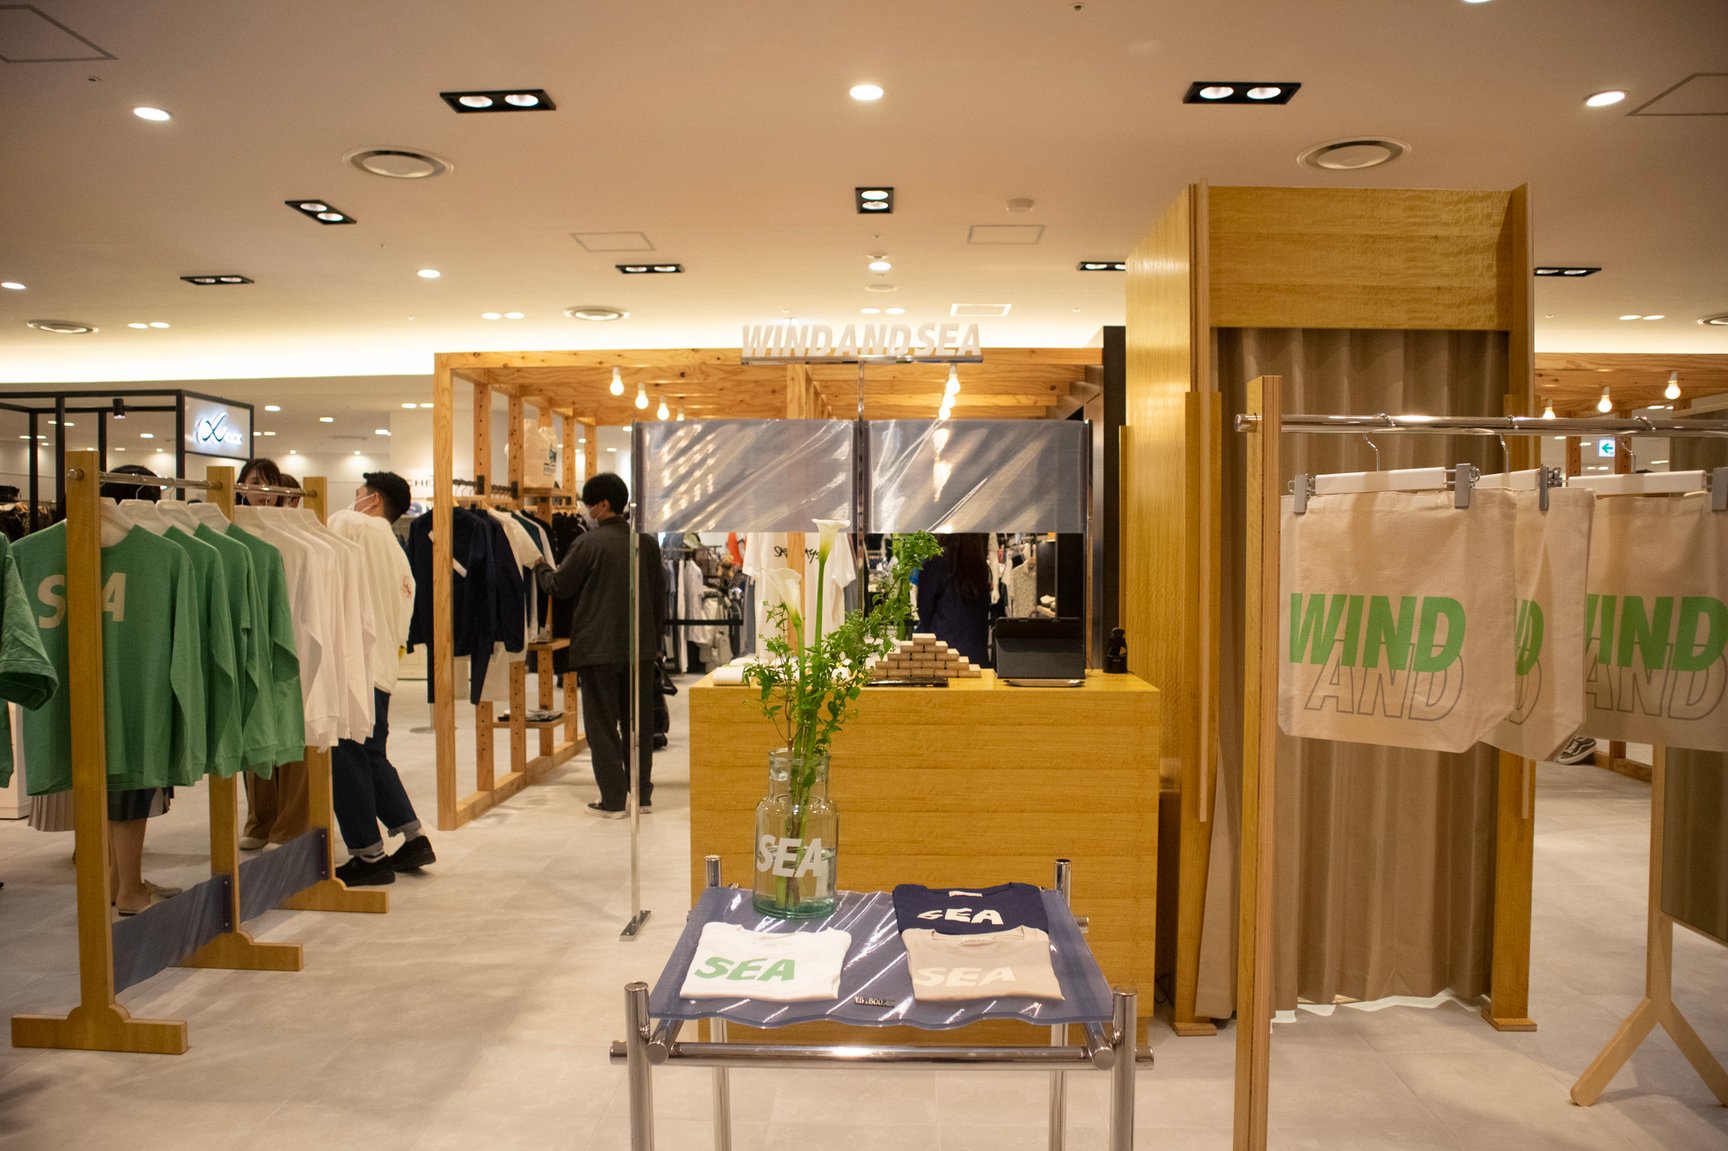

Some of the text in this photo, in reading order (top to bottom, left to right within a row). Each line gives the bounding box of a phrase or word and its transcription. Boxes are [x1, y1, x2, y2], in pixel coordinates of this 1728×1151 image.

[37, 571, 126, 629] SA
[1289, 593, 1466, 672] WIND
[1586, 594, 1728, 672] IND
[1304, 639, 1464, 721] AND
[756, 834, 822, 878] SEA
[916, 907, 1004, 926] SEA
[694, 956, 796, 982] SEA
[914, 966, 1017, 988] SEA
